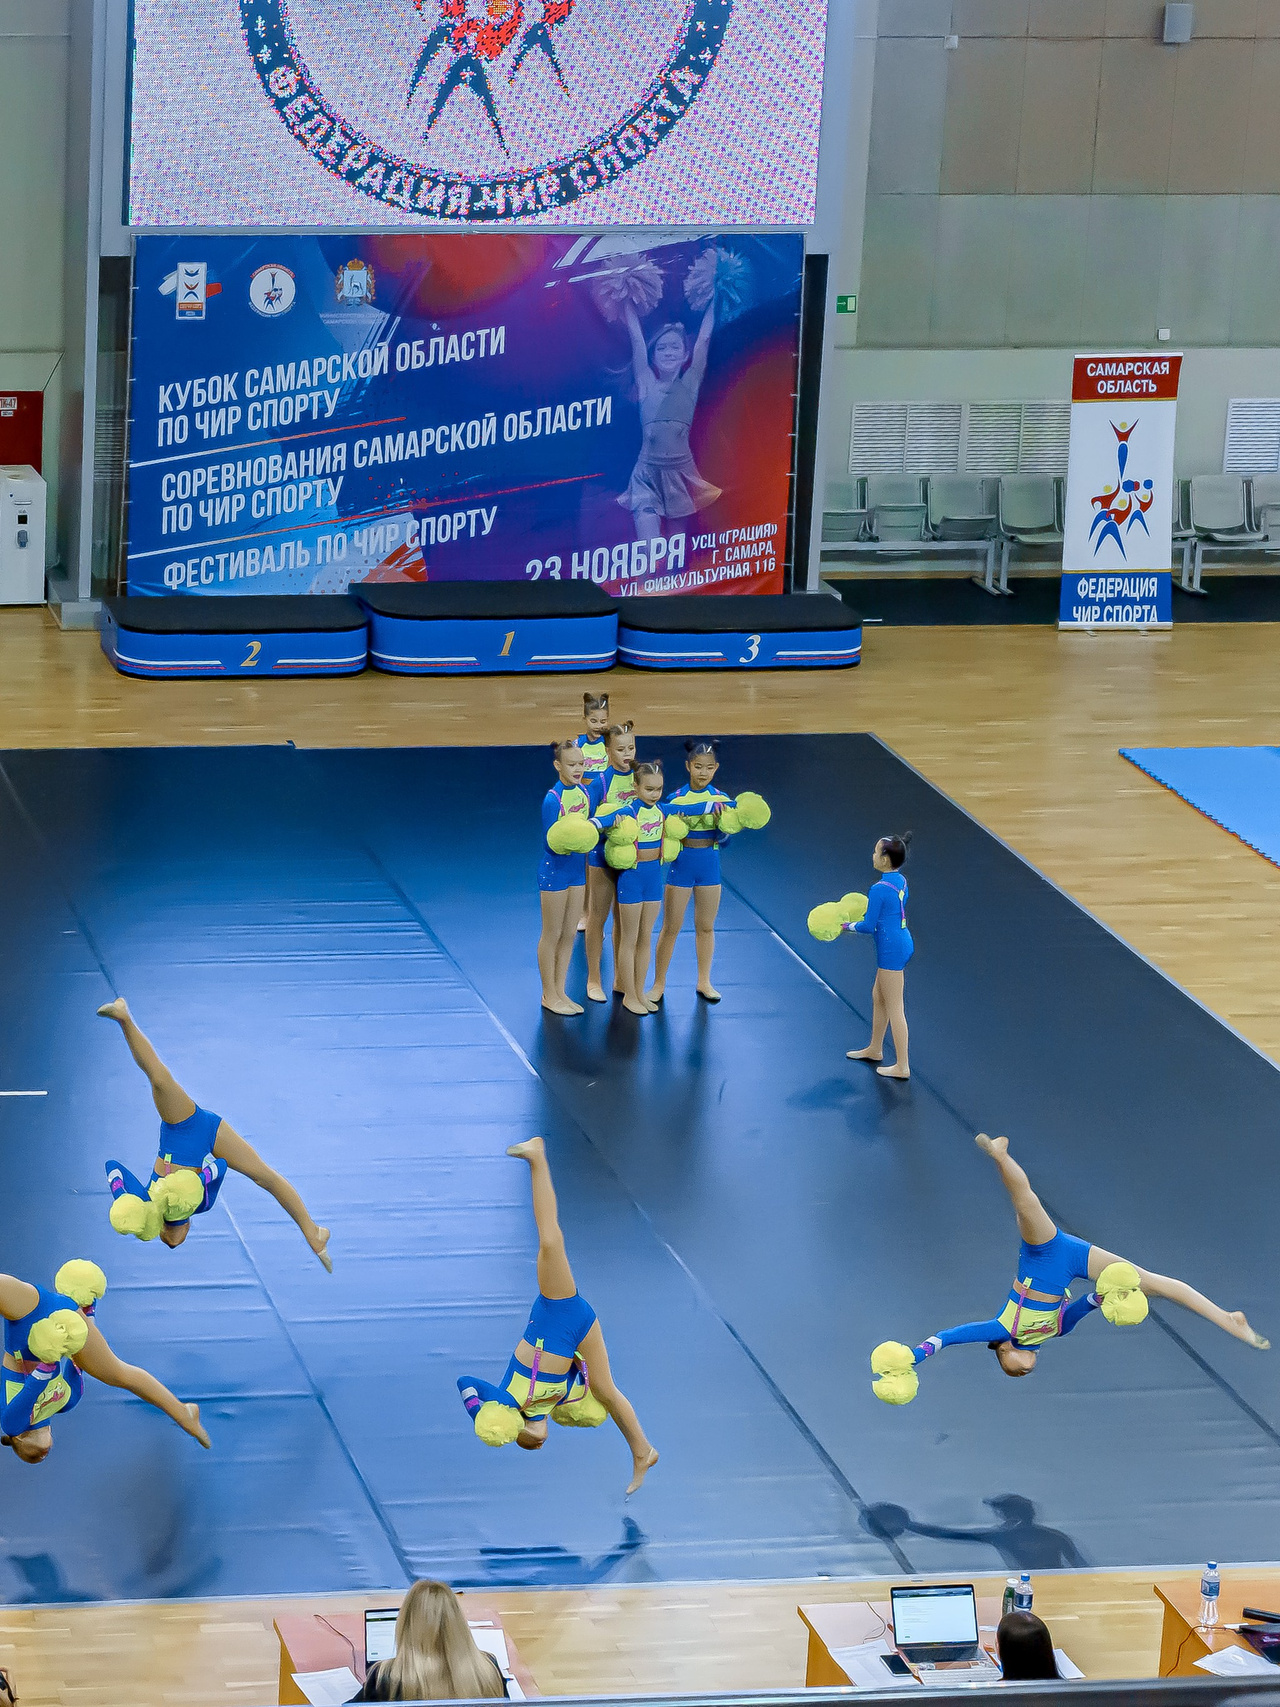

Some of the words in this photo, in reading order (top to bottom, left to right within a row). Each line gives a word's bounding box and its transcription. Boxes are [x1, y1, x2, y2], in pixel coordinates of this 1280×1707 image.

[158, 371, 239, 413] КУБОК
[245, 341, 389, 397] САМАРСКОЙ
[395, 325, 506, 372] ОБЛАСТИ
[1086, 360, 1170, 377] САМАРСКАЯ
[1097, 378, 1157, 395] ОБЛАСТЬ
[157, 415, 189, 447] ПО
[195, 405, 242, 439] ЧИР
[247, 387, 341, 431] СПОРТУ
[161, 442, 347, 502] СОРЕВНОВАНИЯ
[353, 412, 497, 468] САМАРСКОЙ
[503, 395, 612, 443] ОБЛАСТИ
[161, 502, 193, 535] ПО
[199, 496, 246, 528] ЧИР
[251, 475, 344, 519] СПОРТУ
[163, 540, 311, 590] ФЕСТИВАЛЬ
[316, 532, 348, 565] ПО
[353, 522, 400, 558] ЧИР
[405, 505, 498, 548] СПОРТУ
[691, 532, 717, 551] УСЦ
[718, 522, 778, 545] «ГРАЦИЯ»
[525, 555, 562, 581] 23
[570, 532, 686, 584] НОЯБРЯ
[712, 549, 722, 564] Г.
[725, 540, 776, 562] САМАРА,
[644, 561, 753, 593] ФИЗКУЛЬТУРНАЯ,
[755, 556, 776, 575] 116
[1076, 576, 1158, 602] ФЕДЕРАЦИЯ
[1072, 606, 1101, 622] ЧИР
[1106, 604, 1159, 622] СПОРТА
[240, 641, 262, 667] 2
[497, 631, 515, 657] 1
[738, 634, 762, 663] 3
